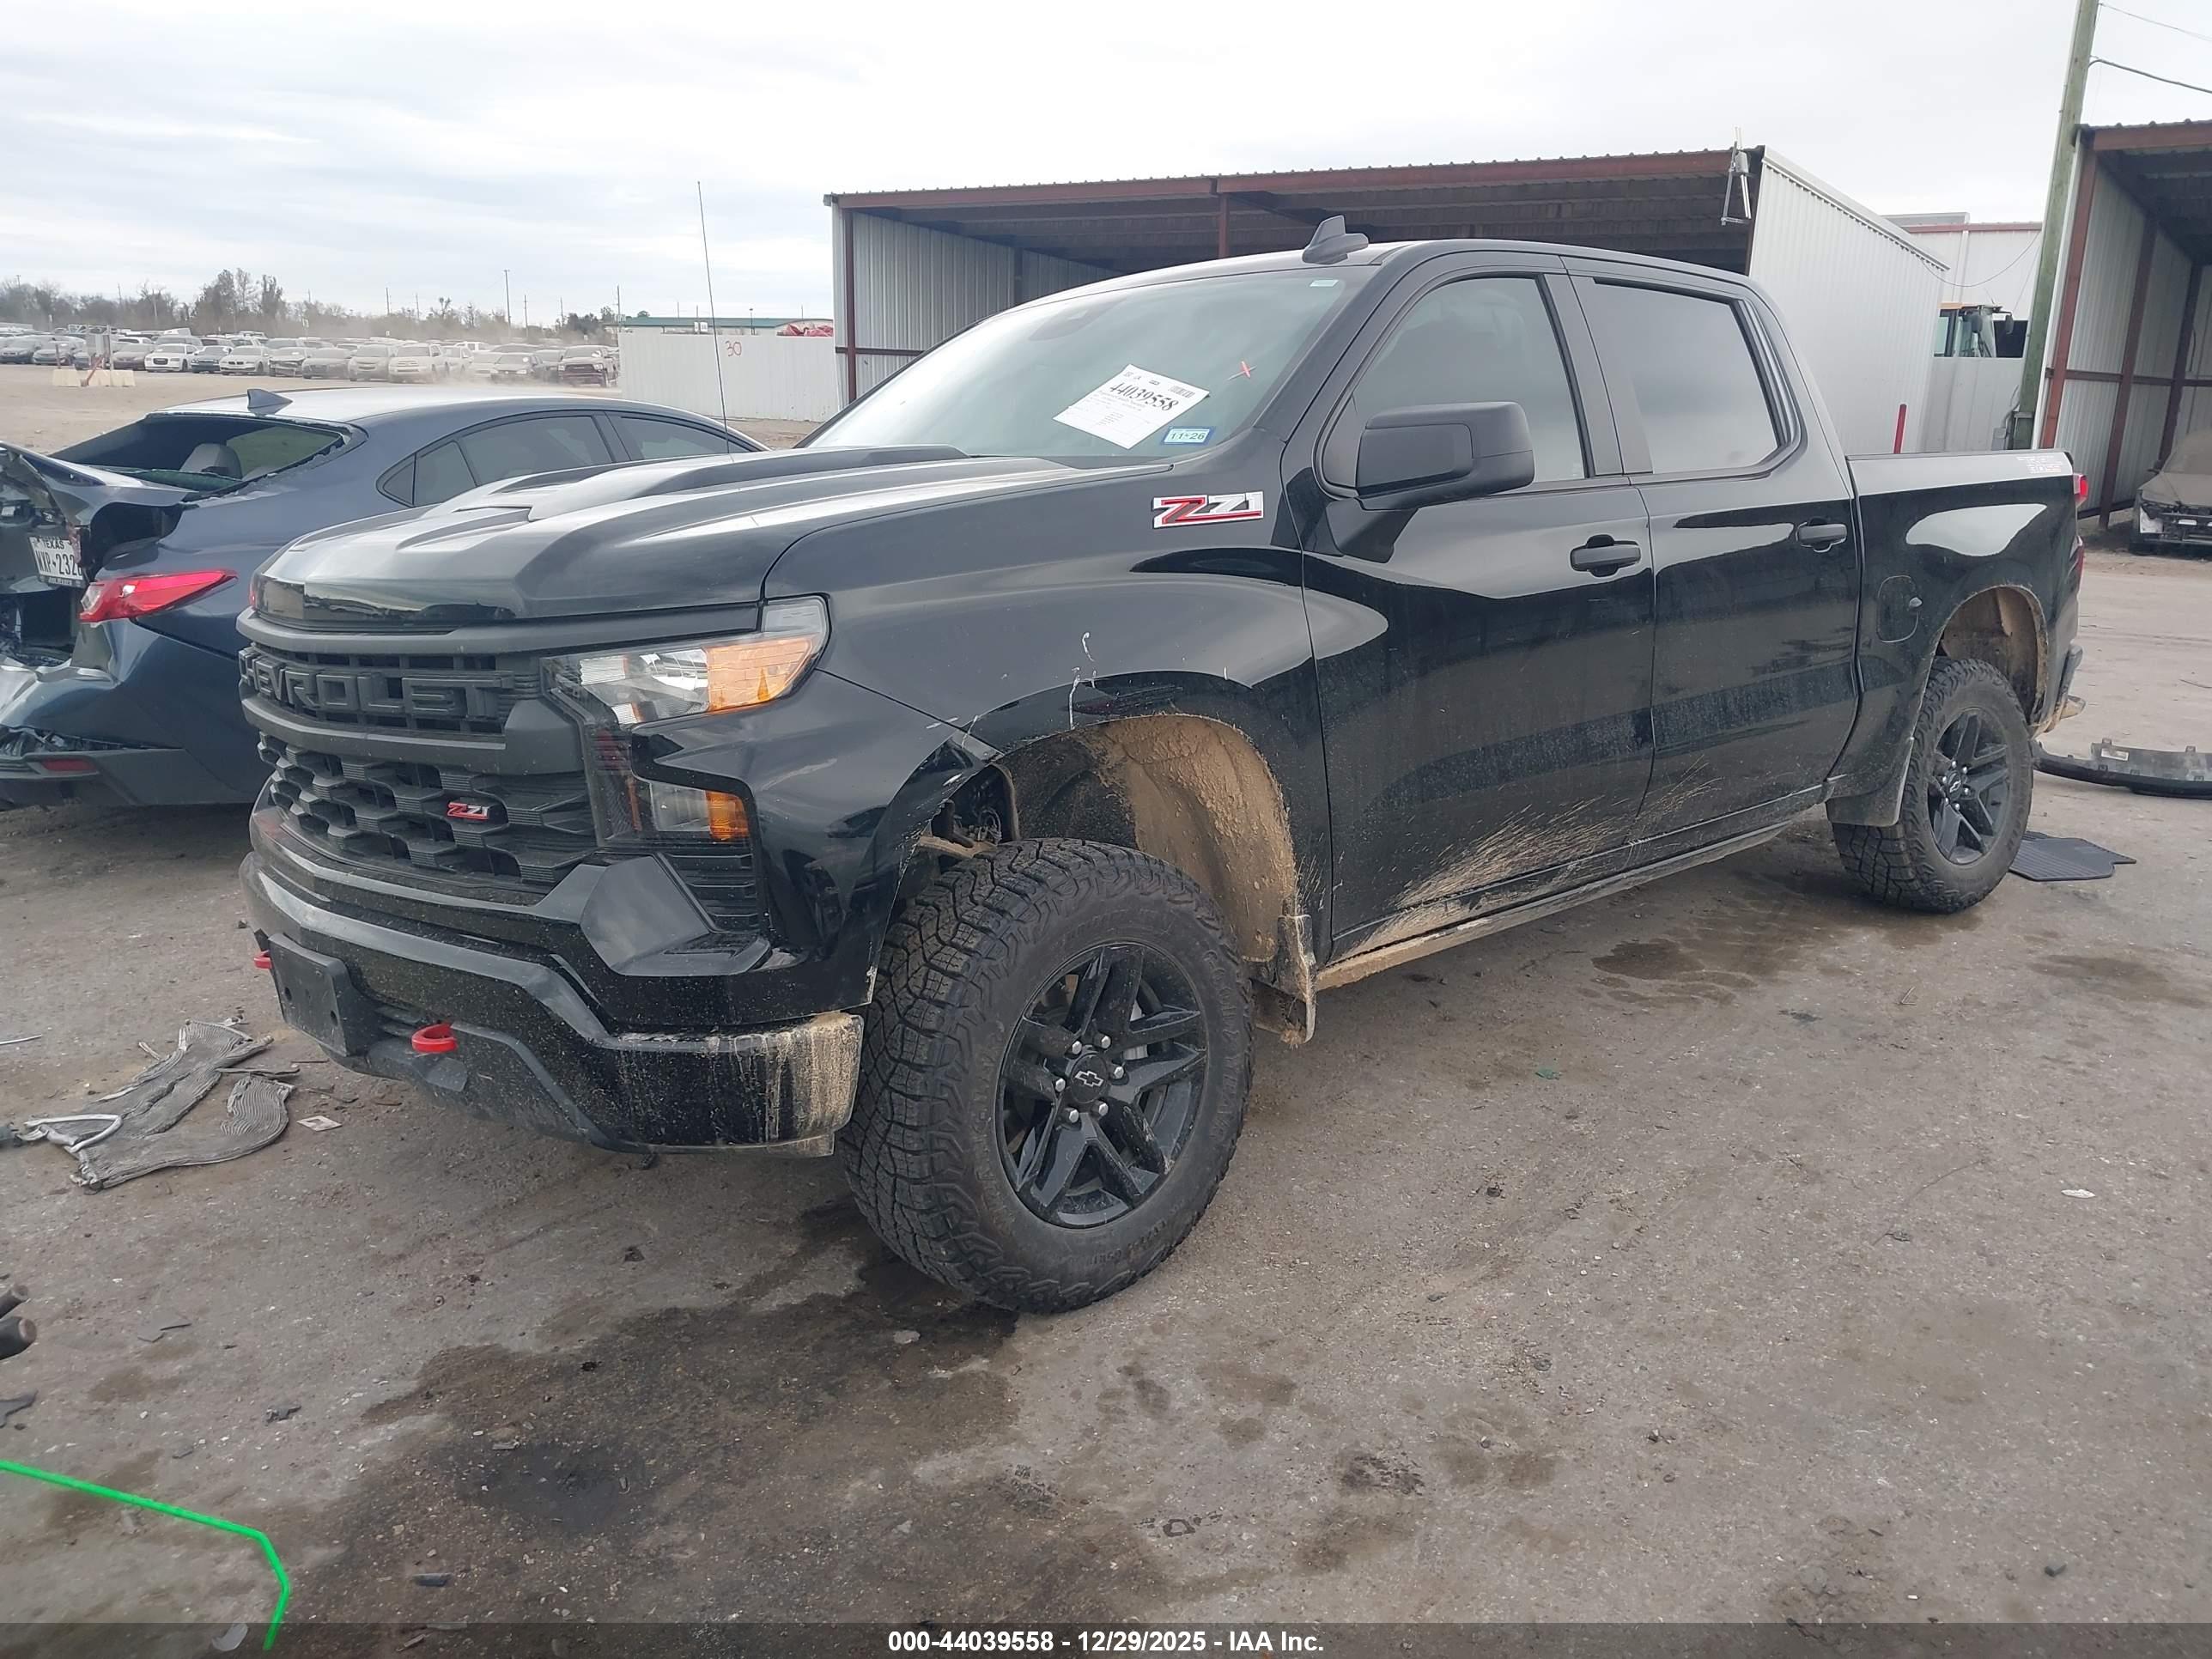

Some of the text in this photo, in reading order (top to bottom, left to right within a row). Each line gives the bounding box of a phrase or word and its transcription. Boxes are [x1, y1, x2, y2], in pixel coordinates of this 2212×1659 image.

[726, 341, 742, 357] 30
[1109, 381, 1180, 412] 44039558
[1152, 491, 1264, 529] Z71
[43, 540, 64, 550] TEXAS
[447, 802, 490, 820] Z71
